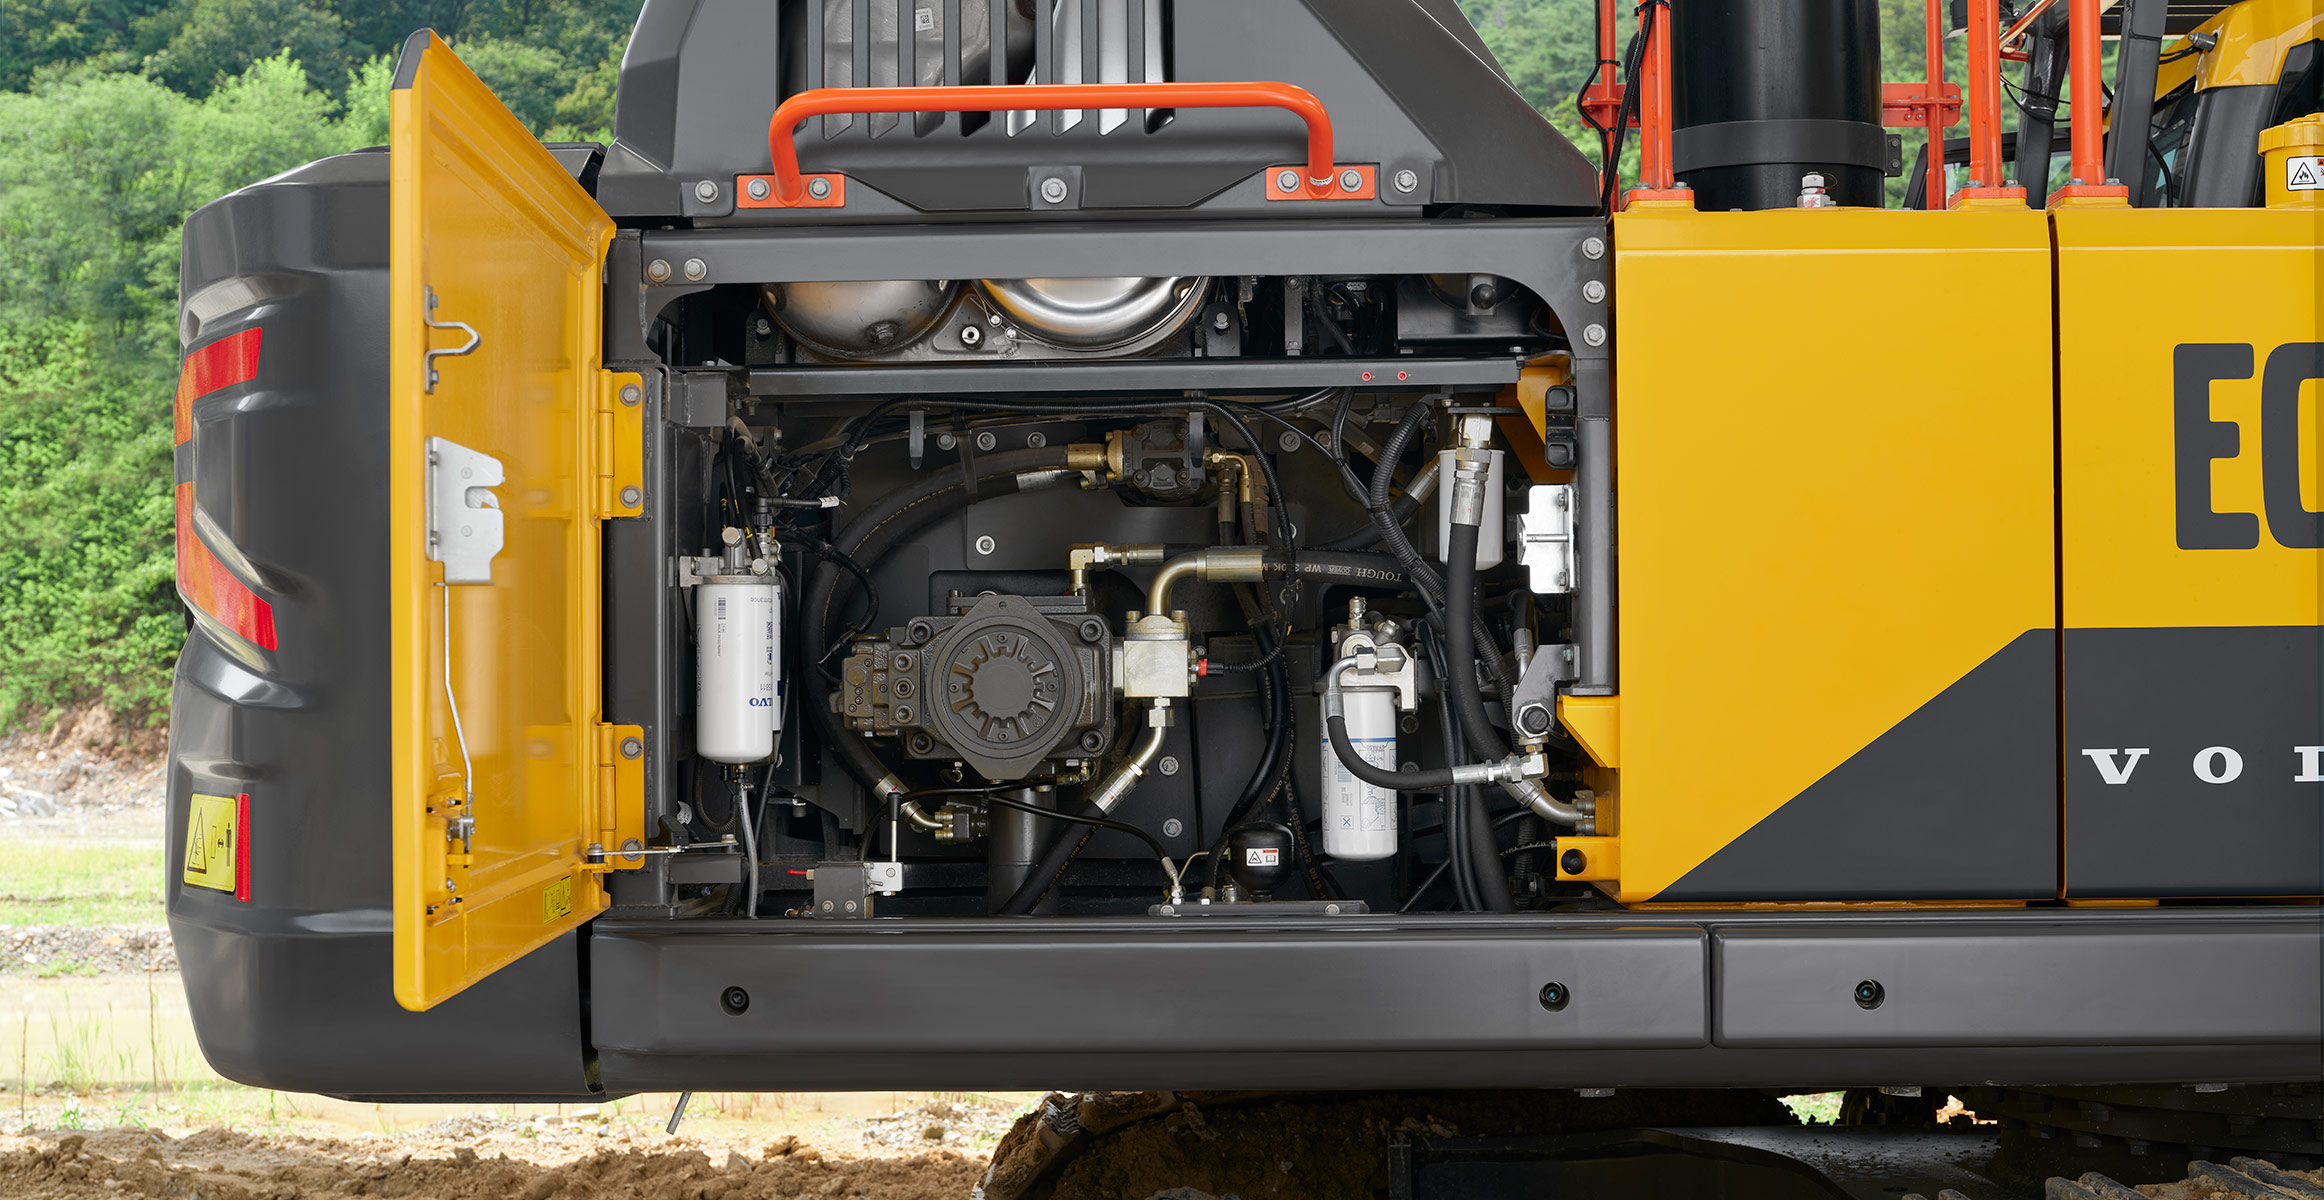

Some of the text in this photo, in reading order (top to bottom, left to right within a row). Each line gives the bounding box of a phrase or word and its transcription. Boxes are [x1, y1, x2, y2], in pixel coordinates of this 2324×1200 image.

[1273, 563, 1300, 572] 30K
[1304, 564, 1322, 573] WP
[1328, 565, 1351, 576] COVER
[1356, 568, 1402, 582] TOUGH
